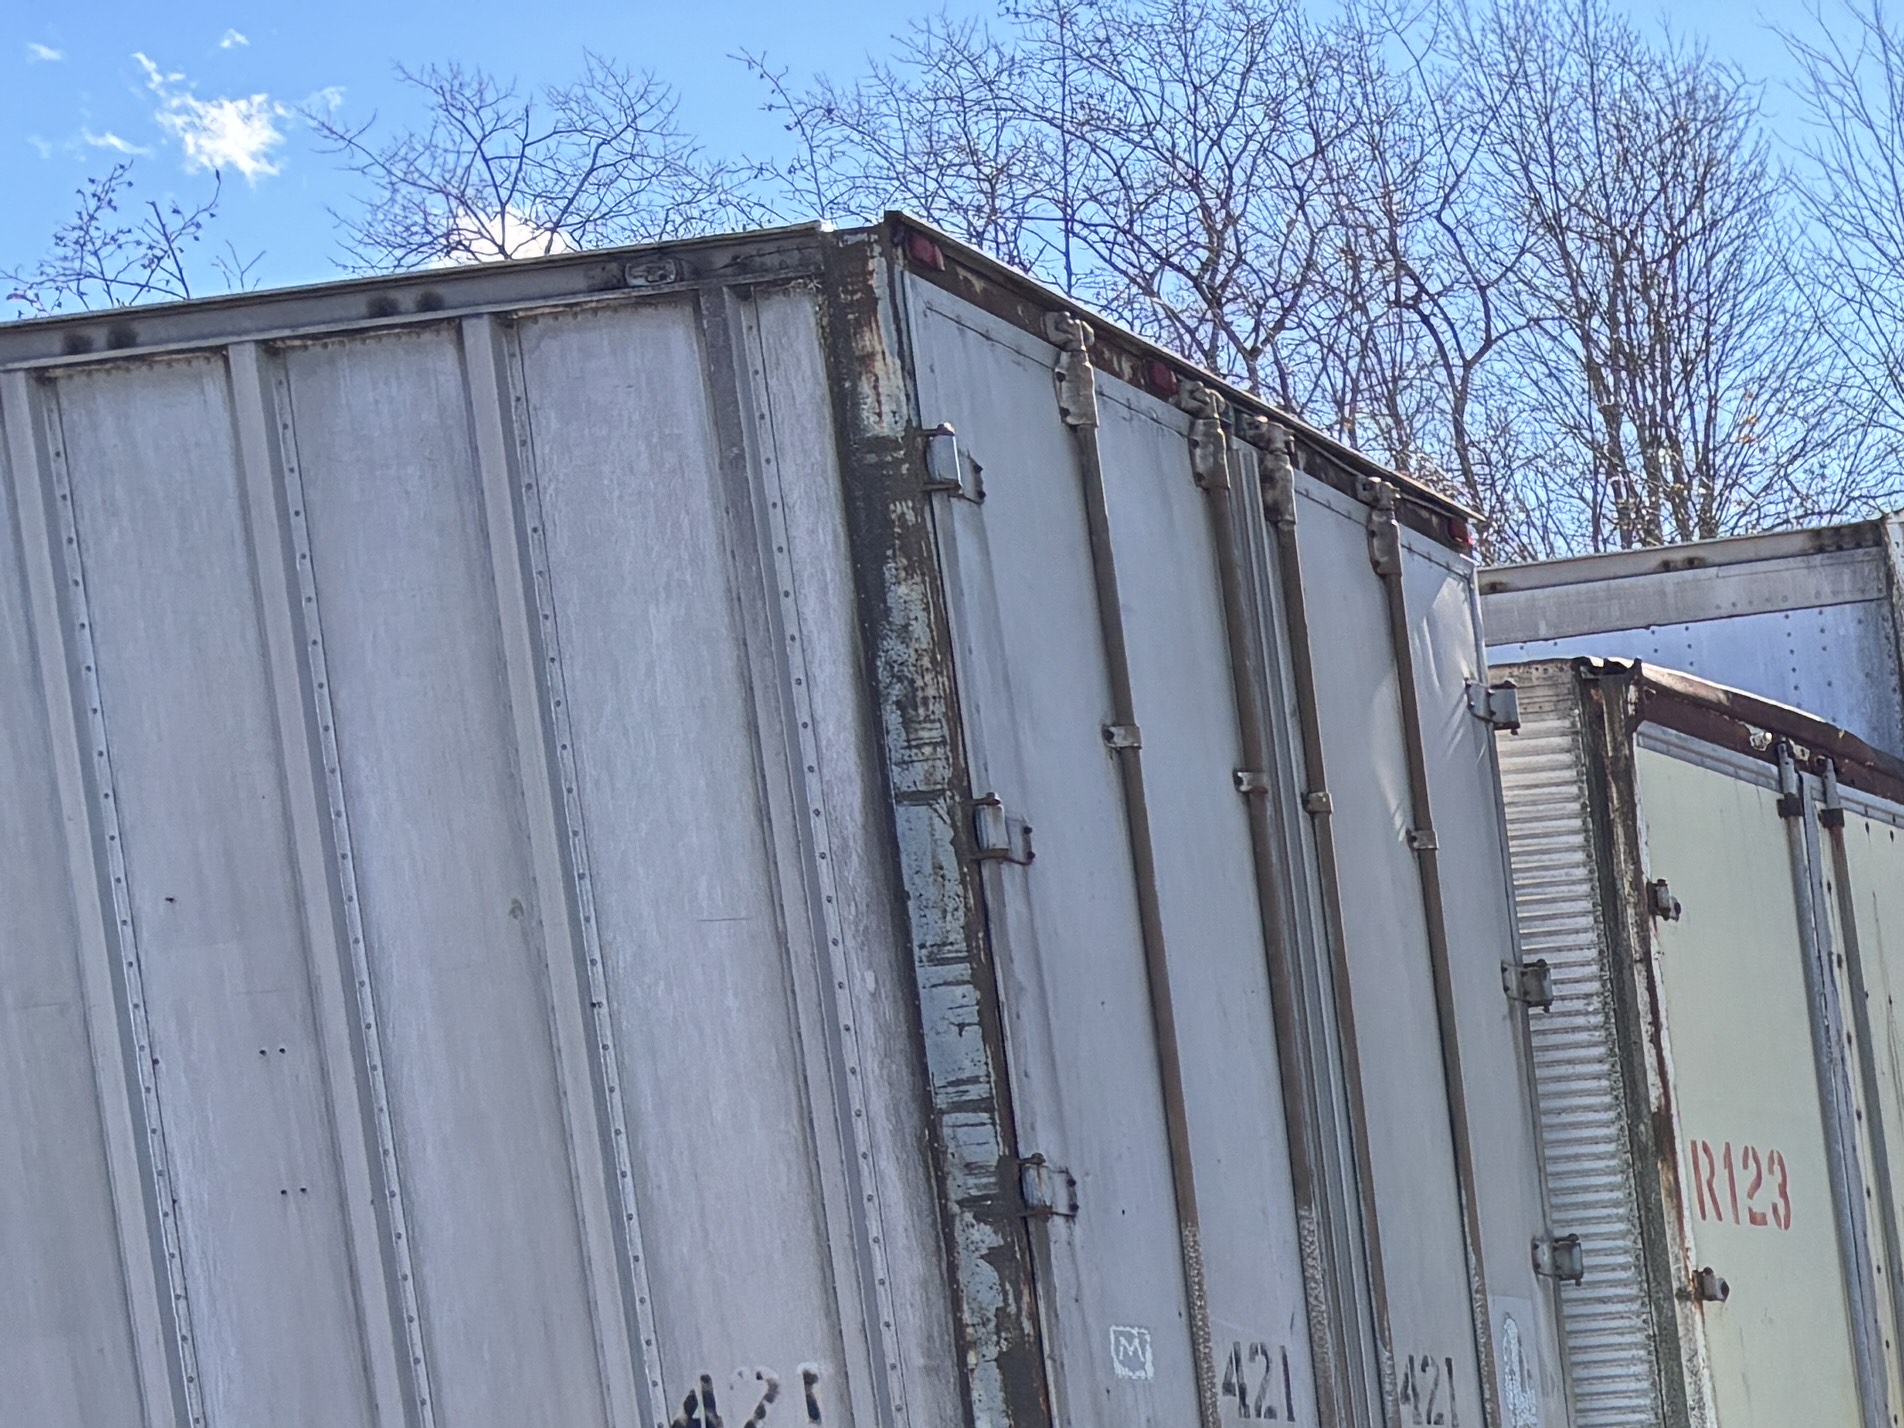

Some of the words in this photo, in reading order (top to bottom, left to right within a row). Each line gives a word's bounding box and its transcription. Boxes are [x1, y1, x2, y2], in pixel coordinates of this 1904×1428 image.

[1691, 1139, 1792, 1231] R123
[1221, 1341, 1296, 1424] 421
[1399, 1354, 1460, 1428] 421
